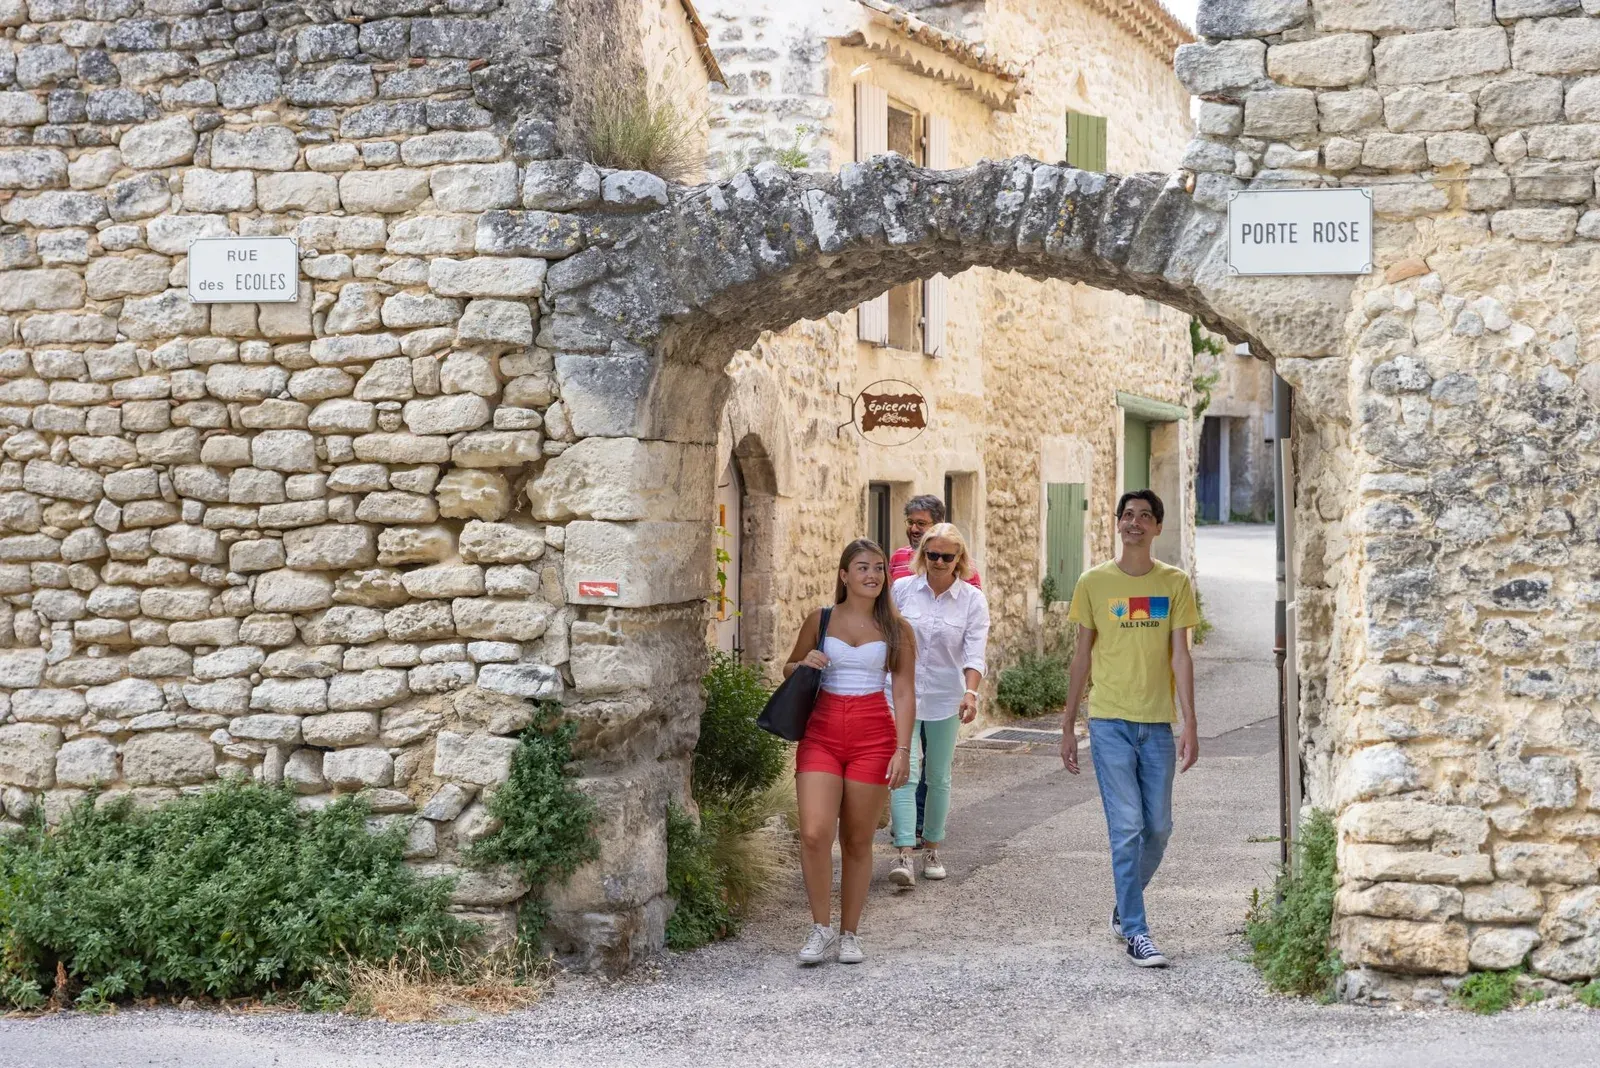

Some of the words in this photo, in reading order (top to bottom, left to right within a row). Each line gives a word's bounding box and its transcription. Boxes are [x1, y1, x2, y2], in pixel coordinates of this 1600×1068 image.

[1241, 223, 1298, 245] PORTE
[1312, 221, 1360, 243] ROSE
[227, 249, 258, 262] RUE
[199, 280, 224, 291] des
[235, 273, 286, 291] ECOLES
[868, 399, 918, 415] épicerie
[1140, 620, 1160, 628] NEED
